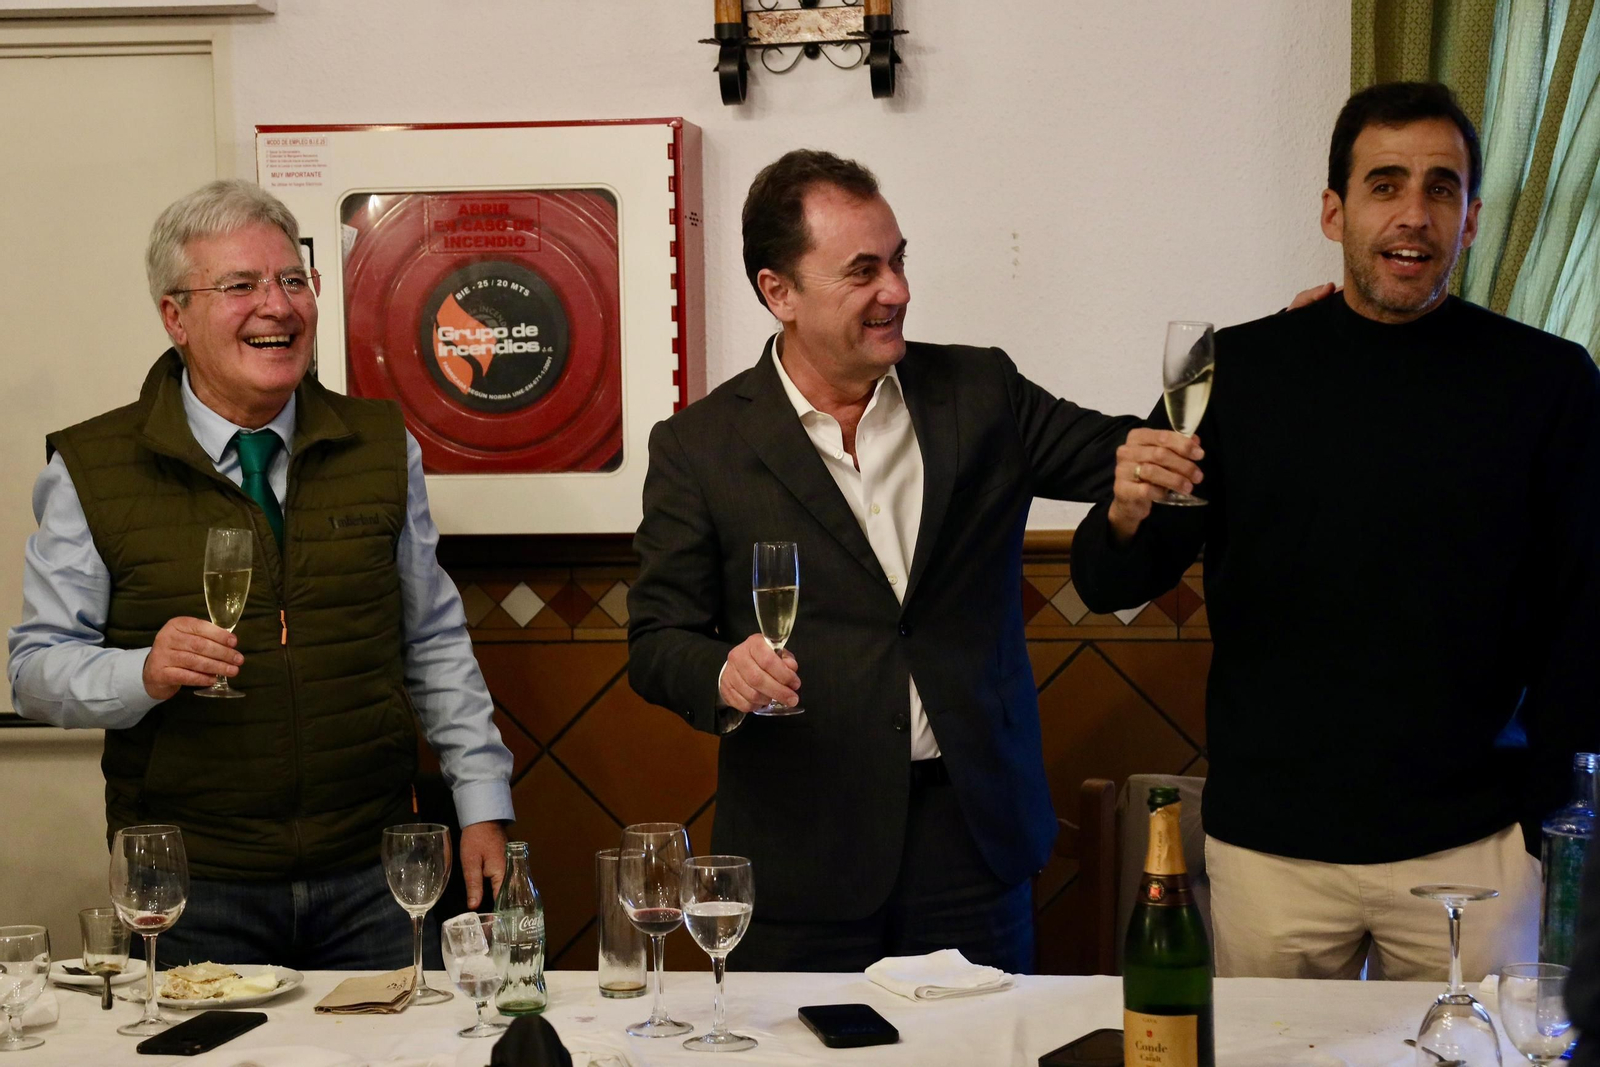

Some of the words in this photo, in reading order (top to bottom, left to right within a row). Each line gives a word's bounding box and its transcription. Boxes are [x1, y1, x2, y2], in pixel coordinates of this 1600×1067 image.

[457, 203, 510, 216] ABRIR
[433, 220, 457, 233] EN
[460, 219, 506, 232] CASO
[511, 218, 535, 231] DE
[442, 235, 526, 248] INCENDIO
[455, 286, 471, 300] BIE
[477, 279, 489, 289] 25
[496, 279, 508, 288] 20
[510, 282, 530, 297] MTS
[437, 325, 509, 342] Grupo
[511, 322, 539, 338] de
[437, 339, 540, 357] Incendios
[442, 361, 467, 390] FABRICADA
[1135, 1040, 1168, 1053] Conde
[1140, 1054, 1162, 1063] Caralt
